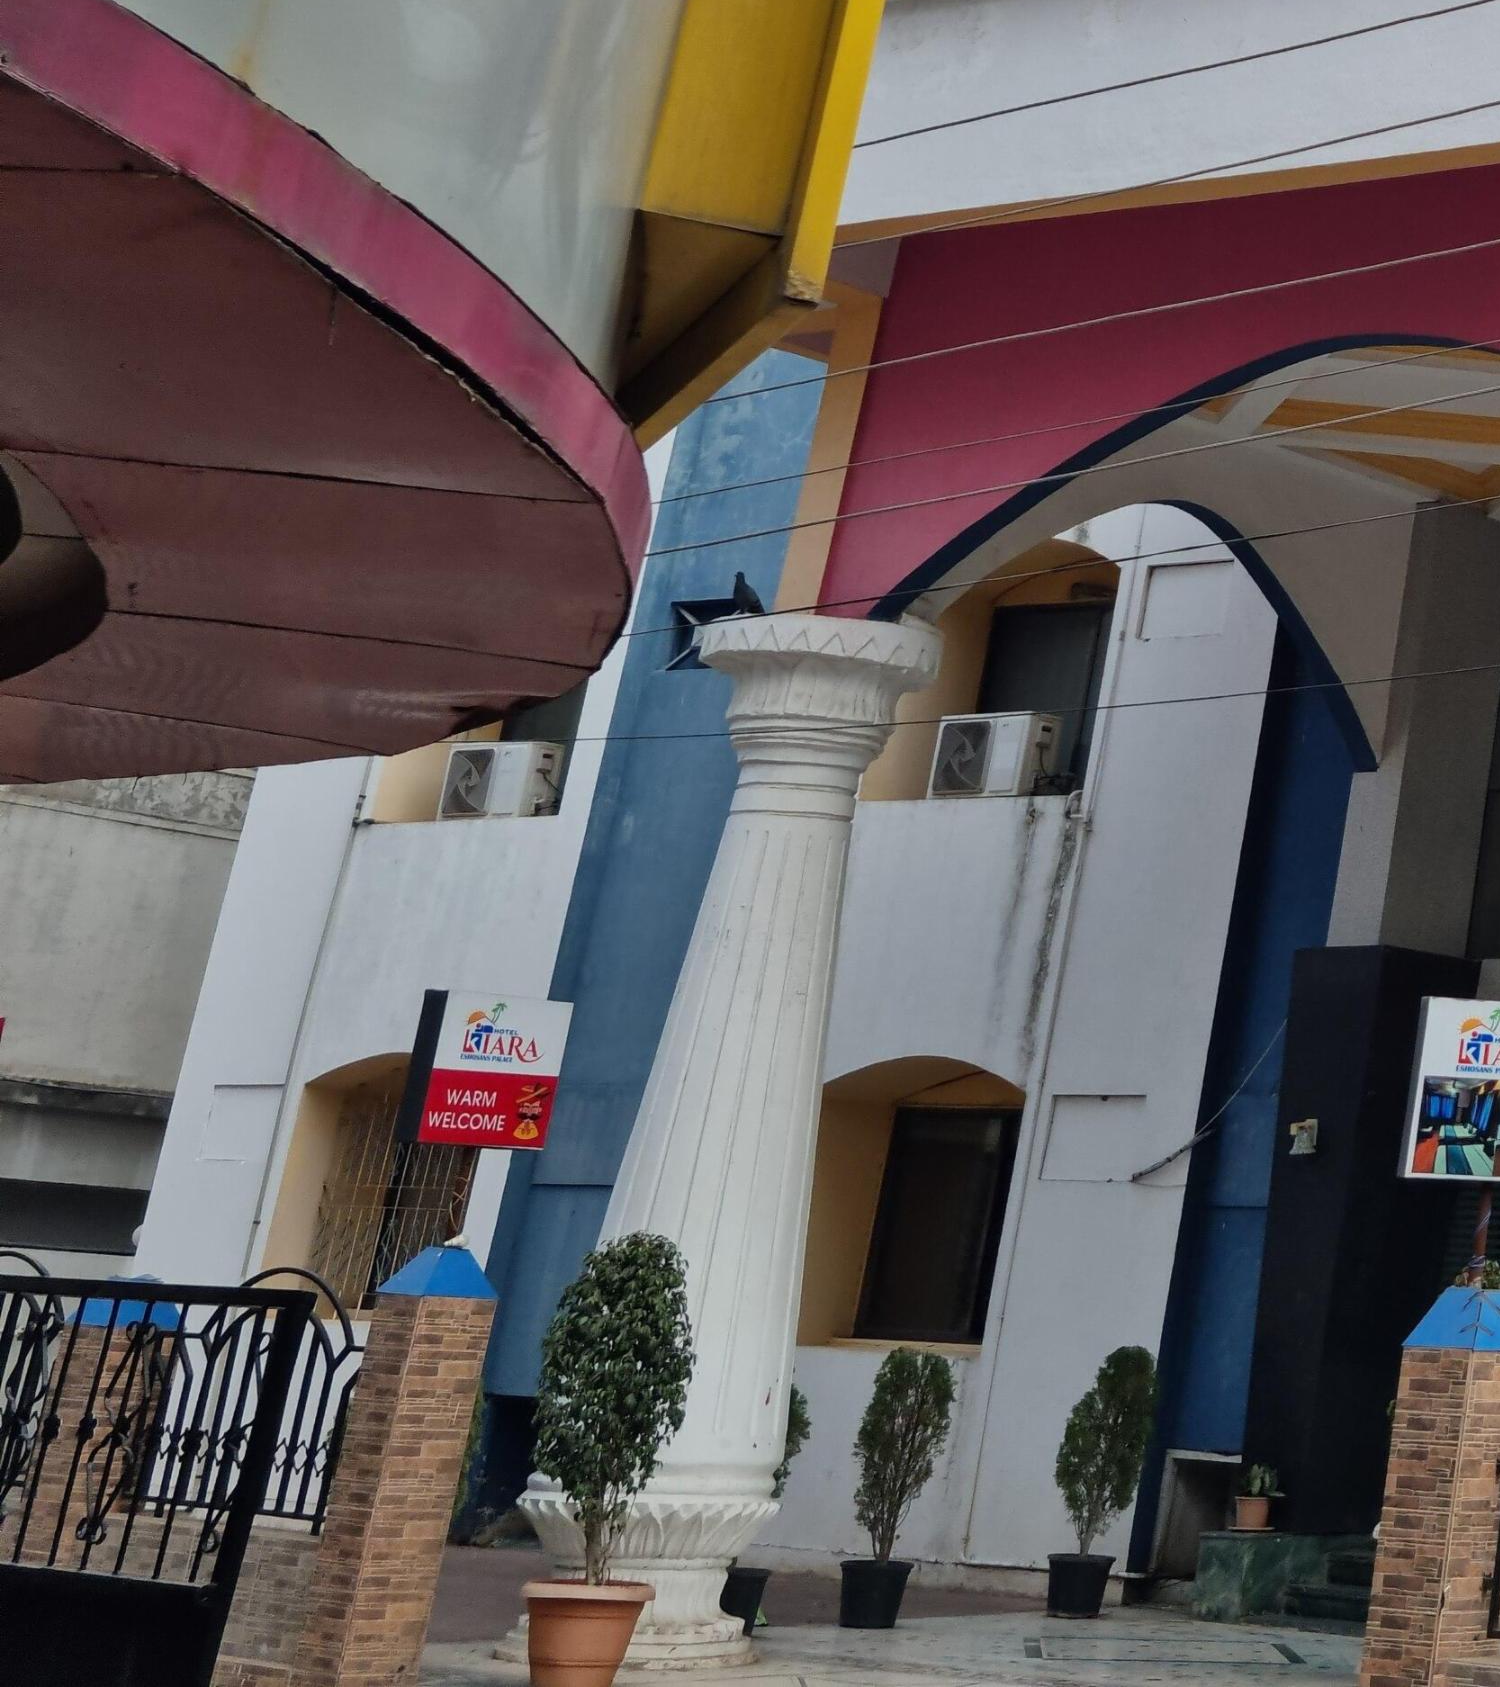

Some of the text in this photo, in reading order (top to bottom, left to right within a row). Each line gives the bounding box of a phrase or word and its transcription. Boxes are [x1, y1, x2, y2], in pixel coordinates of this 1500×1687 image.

[462, 1028, 546, 1064] KIARA
[1455, 1063, 1494, 1075] ESHOSANS
[446, 1088, 498, 1109] WARM
[427, 1110, 507, 1133] WELCOME
